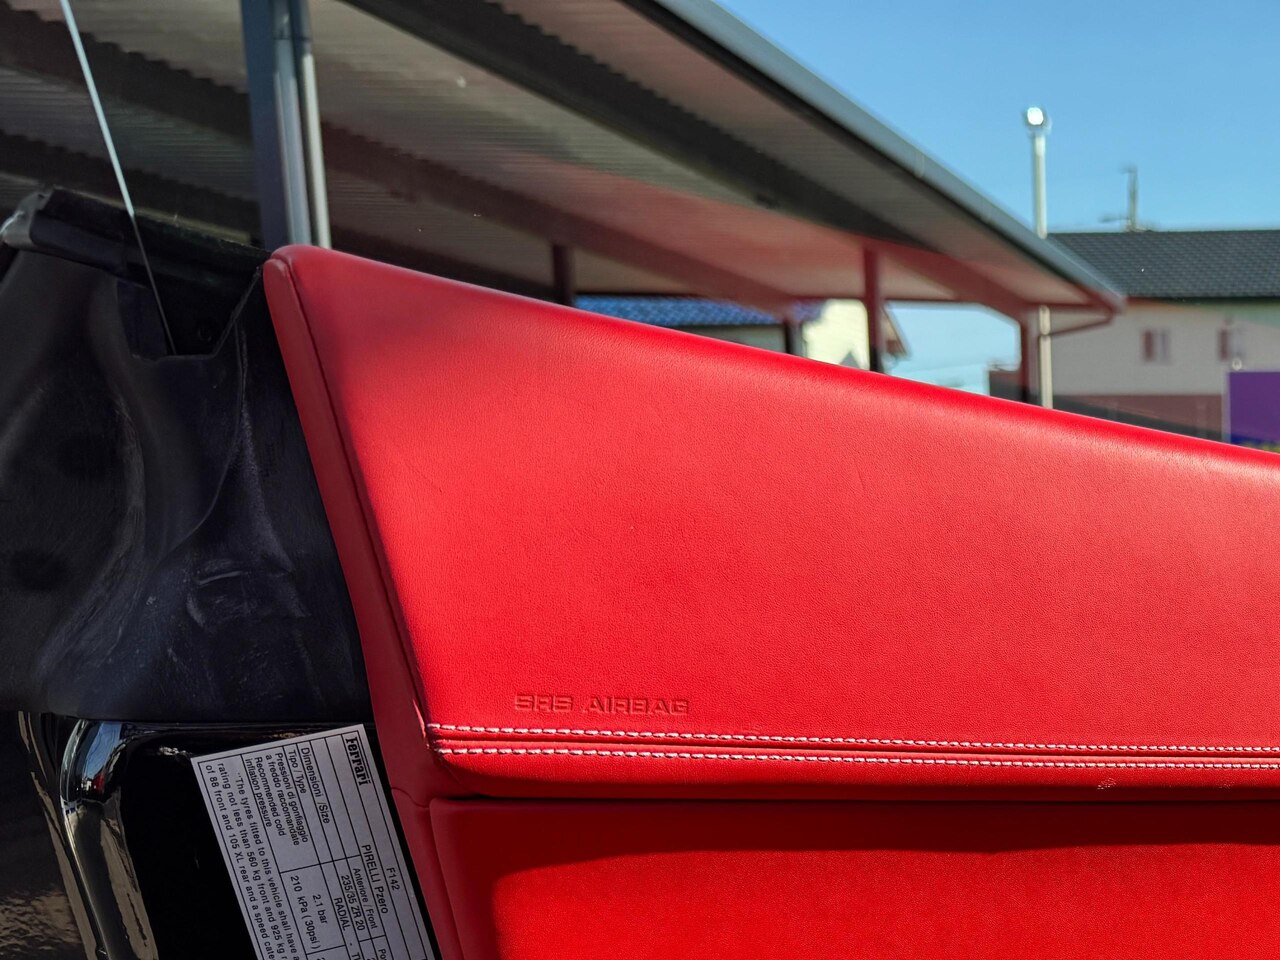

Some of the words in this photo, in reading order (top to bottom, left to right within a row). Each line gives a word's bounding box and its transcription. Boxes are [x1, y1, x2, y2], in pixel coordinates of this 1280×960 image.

[514, 694, 574, 713] SRS
[582, 696, 690, 716] AIRBAG
[205, 765, 216, 774] of
[274, 752, 293, 790] Pressioni
[345, 736, 371, 786] Ferrari
[209, 776, 220, 788] 88
[217, 763, 231, 789] rating
[300, 747, 324, 798] Dimensioni
[214, 790, 227, 812] front
[226, 791, 238, 807] not
[245, 758, 261, 791] inflation
[254, 792, 272, 827] pressure
[254, 756, 281, 818] Recommended
[274, 818, 287, 837] cold
[287, 791, 296, 800] di
[240, 797, 254, 820] tyres
[268, 761, 281, 788] freddo
[277, 789, 300, 846] raccomandate
[221, 814, 234, 831] and
[232, 808, 244, 827] less
[288, 800, 309, 843] gonfiaggio
[228, 833, 240, 849] 105
[239, 829, 251, 849] than
[249, 821, 263, 845] fitted
[288, 749, 299, 768] Tipo
[295, 773, 307, 794] Type
[333, 897, 351, 931] RADIAL
[234, 851, 244, 864] XL
[246, 851, 259, 868] 560
[257, 847, 266, 857] to
[239, 865, 250, 883] rear
[252, 869, 261, 881] kg
[261, 858, 272, 875] this
[340, 874, 358, 904] 235/35
[361, 844, 381, 883] PIRELLI
[374, 885, 389, 914] Pzero
[386, 867, 400, 891] F142
[245, 886, 258, 902] and
[257, 883, 270, 904] front
[267, 877, 283, 908] vehicle
[312, 894, 324, 907] 2.1
[352, 868, 369, 903] Anteriore
[365, 908, 378, 929] Front
[264, 906, 277, 923] and
[290, 875, 303, 892] 210
[297, 896, 308, 913] kPa
[304, 920, 320, 944] 30psi
[317, 909, 328, 924] bar
[350, 905, 362, 919] ZR
[254, 912, 270, 939] speed
[278, 910, 292, 931] shall
[355, 919, 366, 931] 20
[270, 924, 283, 941] 925
[286, 932, 297, 954] have
[276, 942, 285, 954] kg
